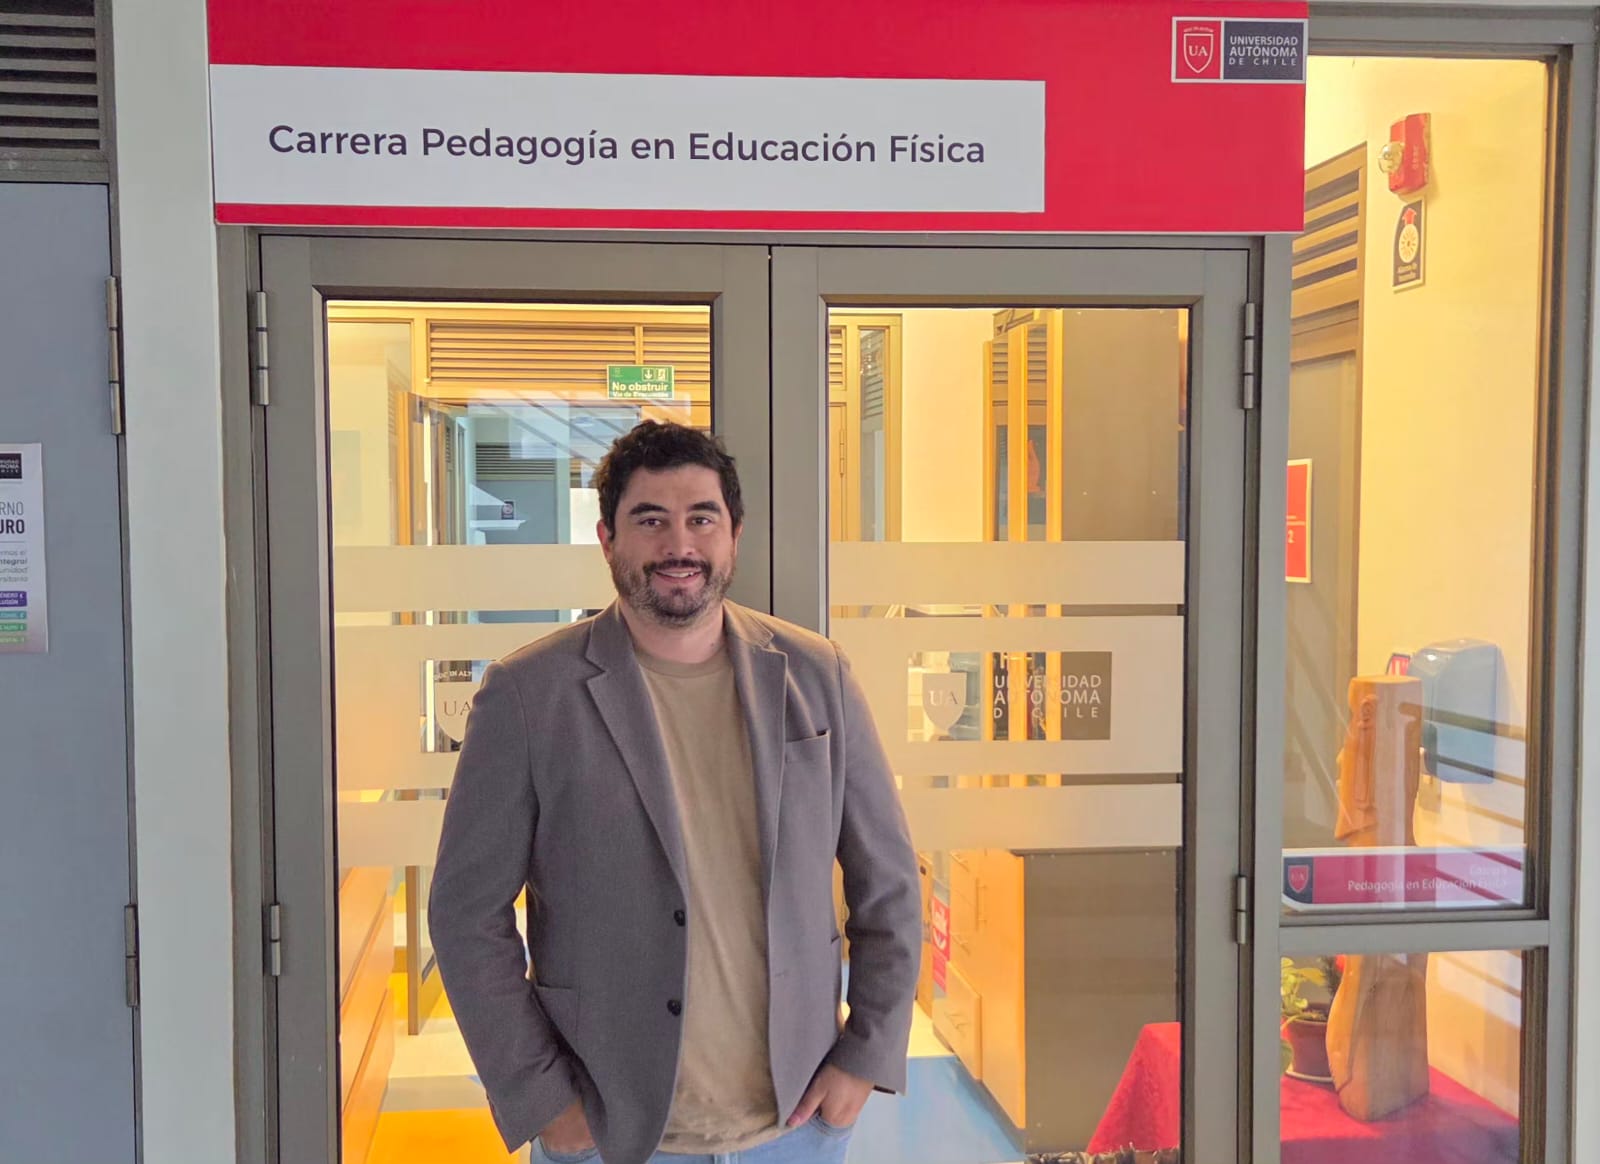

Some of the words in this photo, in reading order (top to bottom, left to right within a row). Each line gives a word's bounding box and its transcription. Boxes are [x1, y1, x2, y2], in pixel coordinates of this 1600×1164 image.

[1230, 36, 1298, 46] UNIVERSIDAD
[1188, 44, 1208, 57] UA
[1229, 46, 1298, 58] AUTÓNOMA
[1229, 58, 1244, 66] DE
[1253, 58, 1297, 66] CHILE
[269, 125, 407, 155] Carrera
[422, 128, 618, 165] Pedagogía
[630, 139, 675, 160] en
[689, 132, 876, 162] Educación
[890, 134, 985, 163] Física
[612, 382, 627, 391] No
[628, 382, 669, 391] obstruir
[444, 700, 472, 717] UA
[1406, 881, 1420, 890] en
